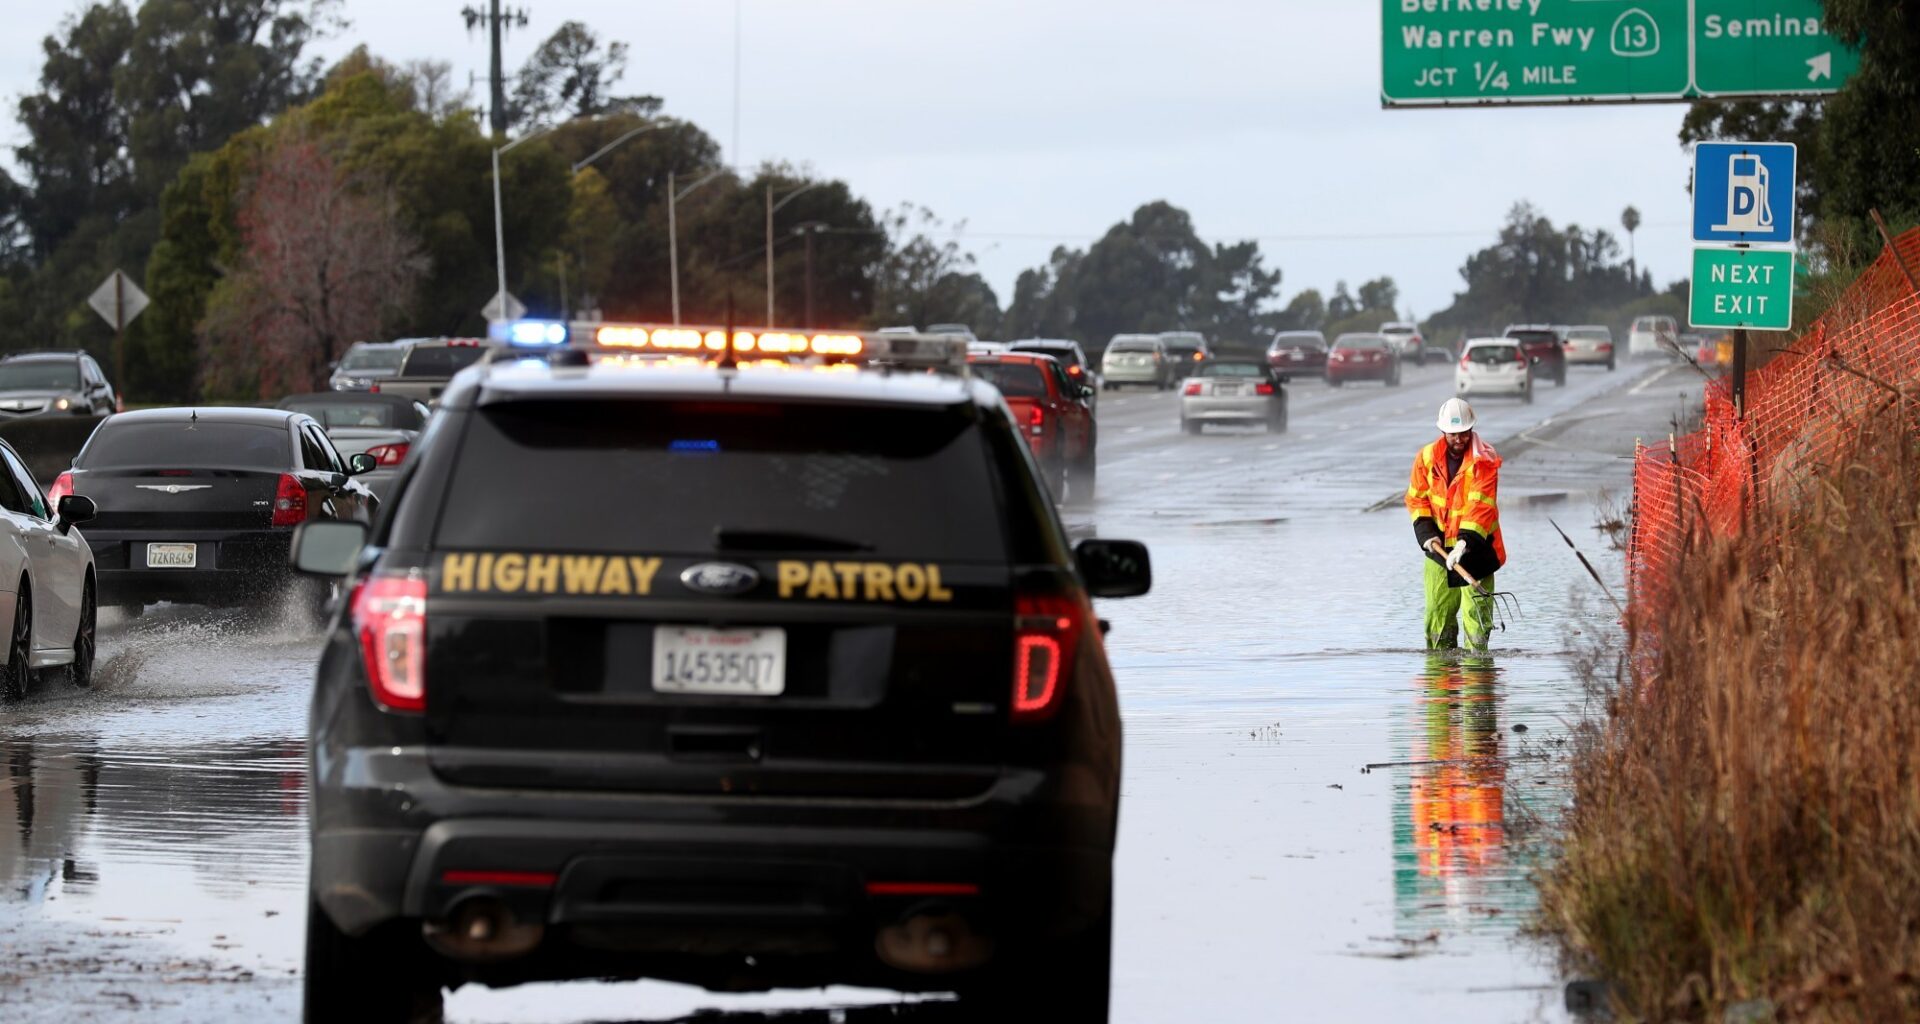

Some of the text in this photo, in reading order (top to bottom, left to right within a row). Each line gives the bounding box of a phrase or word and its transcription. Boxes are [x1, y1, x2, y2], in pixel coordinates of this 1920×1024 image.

[1402, 22, 1594, 51] Warren Fwy
[1623, 25, 1647, 48] 13
[1705, 14, 1828, 38] Semina
[1414, 68, 1457, 86] JCT
[1522, 66, 1577, 85] MILE
[1733, 186, 1755, 215] D
[1712, 264, 1774, 284] NEXT
[1714, 294, 1768, 315] EXIT
[442, 552, 662, 595] HIGHWAY
[777, 560, 953, 601] PATROL
